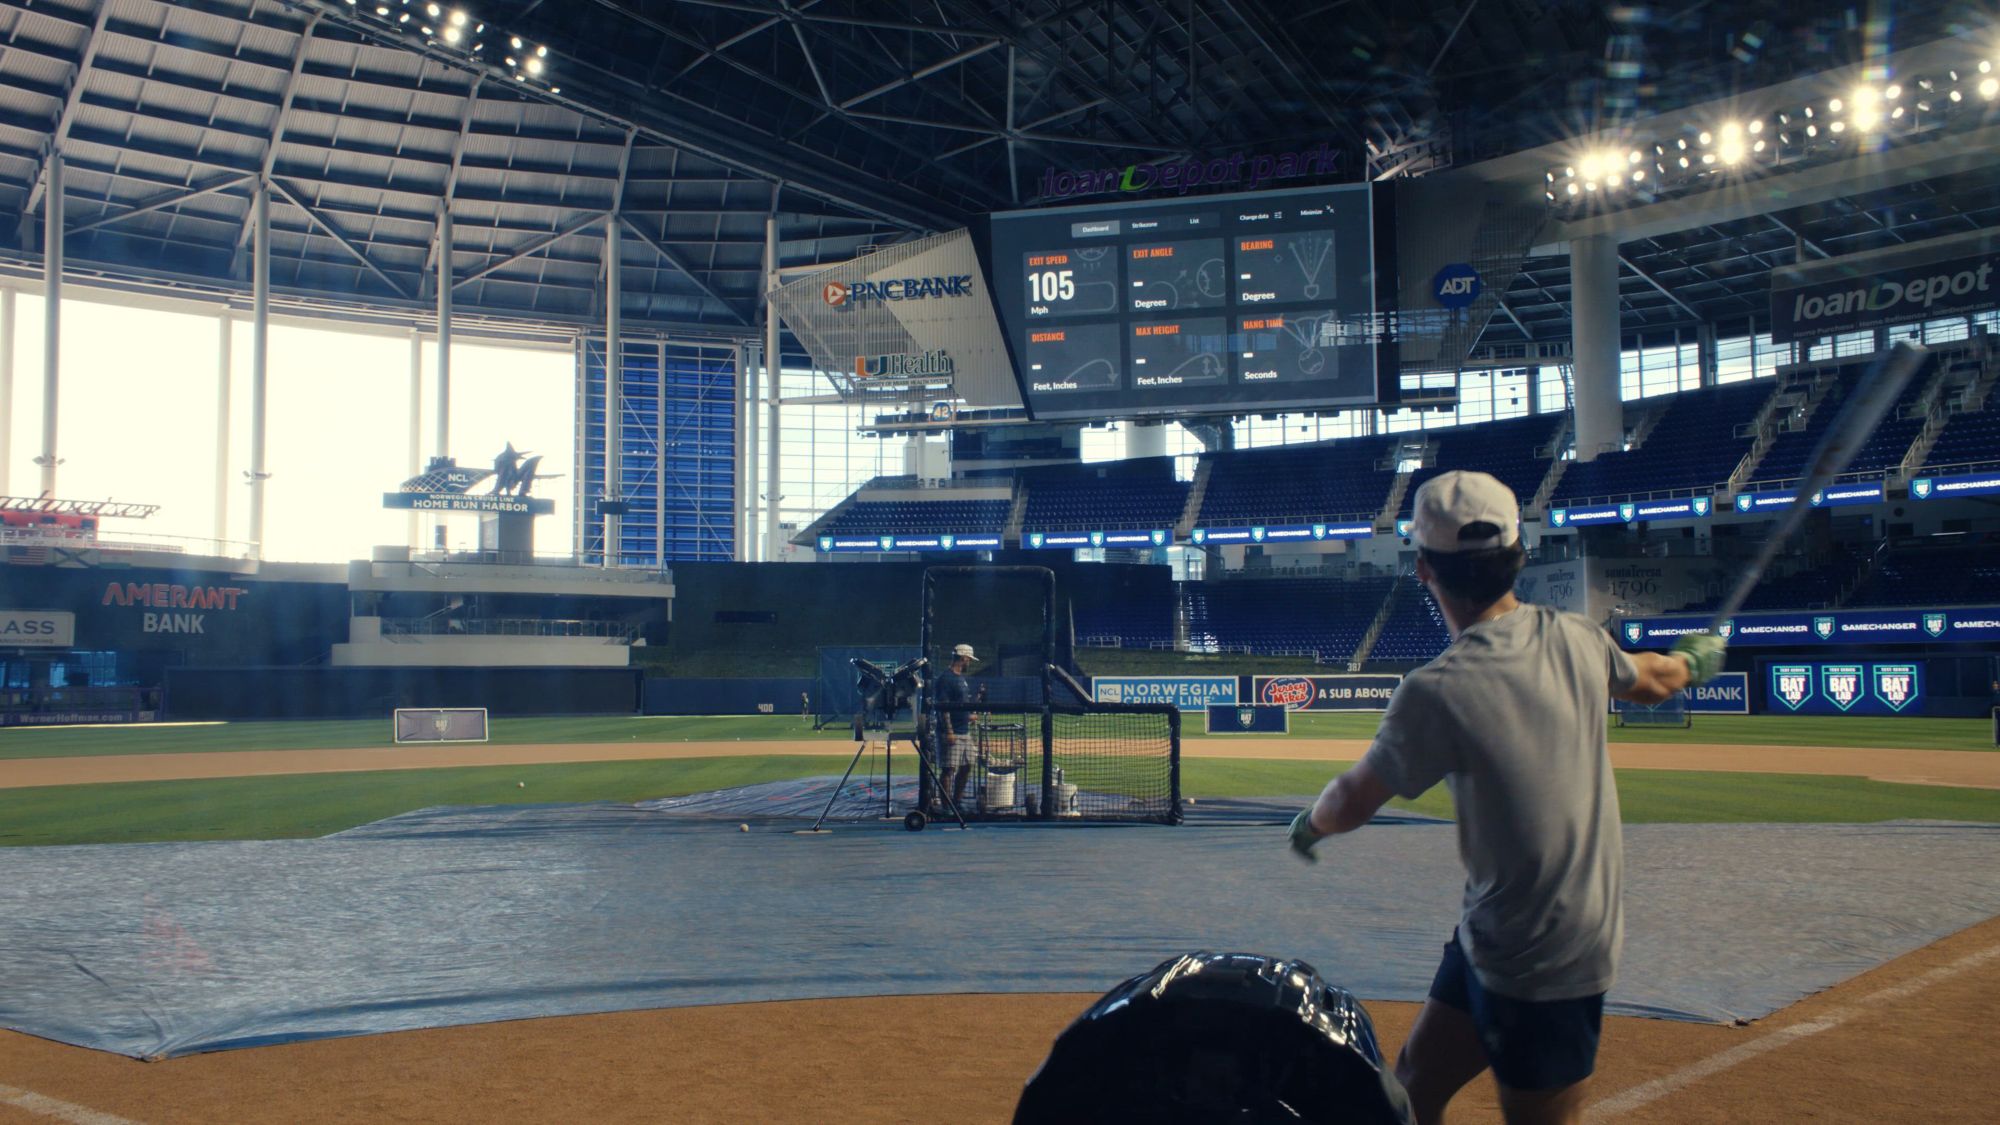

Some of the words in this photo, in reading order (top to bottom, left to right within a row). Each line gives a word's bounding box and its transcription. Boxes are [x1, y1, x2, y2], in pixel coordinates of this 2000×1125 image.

[1248, 143, 1341, 189] park
[1240, 240, 1274, 251] BEARING
[1133, 249, 1149, 259] EXIT
[1150, 247, 1174, 258] ANGLE
[1029, 256, 1044, 266] EXIT
[1045, 255, 1068, 265] SPEED
[1028, 270, 1075, 302] 105
[1440, 276, 1476, 295] ADT
[1242, 292, 1276, 302] Degrees
[1793, 262, 1993, 322] loanDepot
[1134, 299, 1168, 309] Degrees
[1031, 306, 1049, 316] Mph
[1243, 320, 1265, 330] HANG
[1266, 318, 1284, 328] TIME
[1136, 326, 1152, 336] MAX
[1153, 324, 1180, 335] HEIGHT
[1031, 332, 1066, 343] DISTANCE
[1244, 370, 1278, 380] Seconds
[1033, 382, 1052, 392] Feet,
[1053, 381, 1078, 390] Inches
[1137, 377, 1157, 386] Feet,
[1158, 376, 1184, 384] Inches
[934, 406, 948, 418] 42
[448, 473, 469, 482] NCL
[1826, 489, 1880, 500] GAMECHANGER
[413, 499, 449, 509] HOME
[453, 500, 478, 510] RUN
[482, 500, 528, 512] HARBOR
[1638, 505, 1689, 515] GAMECHANGER
[1568, 510, 1617, 521] GAMECHANGER
[1611, 579, 1657, 600] 1796
[102, 582, 242, 610] AMERANT
[0, 620, 56, 635] ASS
[143, 612, 205, 634] BANK
[1842, 622, 1917, 631] GAMECHANGER
[1740, 625, 1808, 634] GAMECHANGER
[1346, 662, 1362, 672] 387
[1124, 683, 1234, 696] NORWEGIAN
[1269, 682, 1308, 695] Jersey
[1780, 677, 1806, 692] BAT
[1829, 677, 1856, 692] BAT
[1881, 677, 1910, 692] BAT
[1100, 688, 1120, 696] NCL
[1318, 689, 1327, 699] A
[1330, 688, 1352, 699] SUB
[1354, 688, 1392, 698] ABOVE
[1696, 686, 1742, 700] BANK
[1786, 692, 1802, 700] LAB
[1835, 692, 1852, 700] LAB
[1888, 692, 1905, 700] LAB
[1124, 696, 1174, 704] CRUISE
[1180, 696, 1211, 706] LINE
[758, 704, 774, 713] 400
